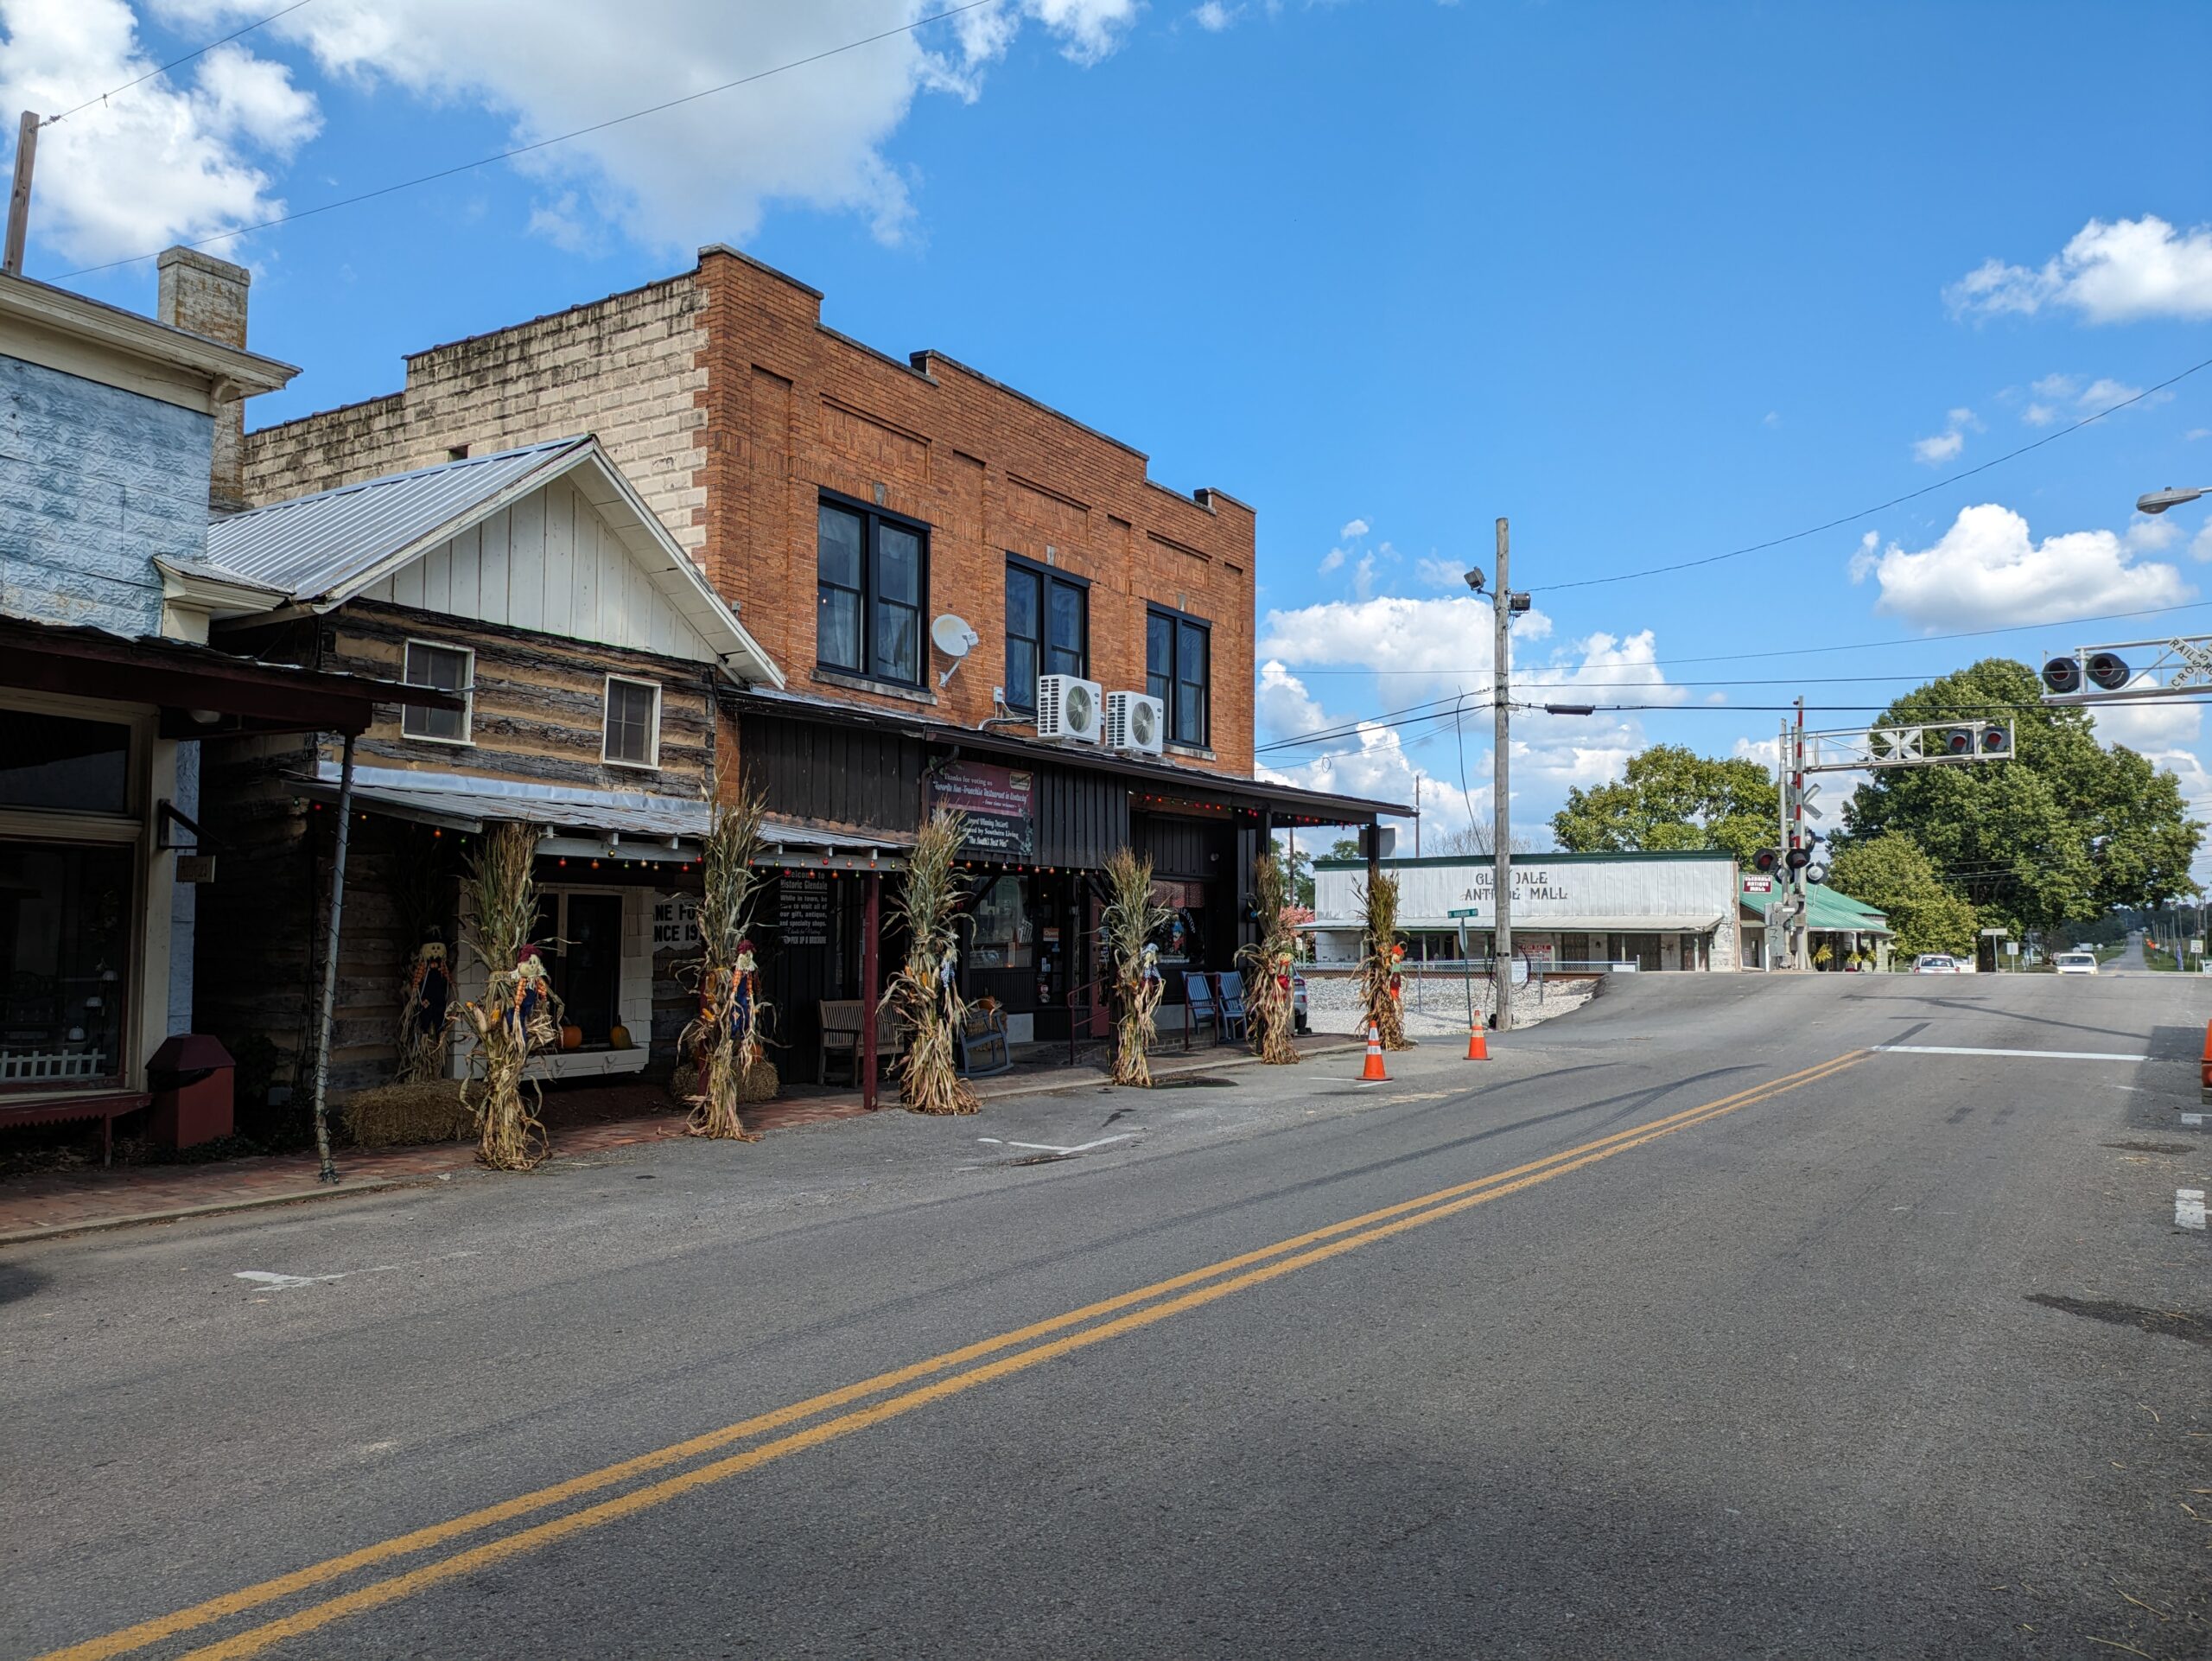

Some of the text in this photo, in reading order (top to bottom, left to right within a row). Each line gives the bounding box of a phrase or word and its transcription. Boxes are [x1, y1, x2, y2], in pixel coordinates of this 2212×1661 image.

[2170, 640, 2194, 660] RAIL
[2171, 644, 2212, 687] CROSSI
[971, 777, 987, 786] voting
[980, 818, 995, 828] Winning
[785, 870, 816, 879] elco
[1475, 872, 1548, 885] GLDALE
[780, 879, 828, 890] Historic Glendale
[1465, 887, 1567, 901] ANTIE MALL
[1185, 912, 1196, 933] STOP
[654, 925, 680, 942] NCE
